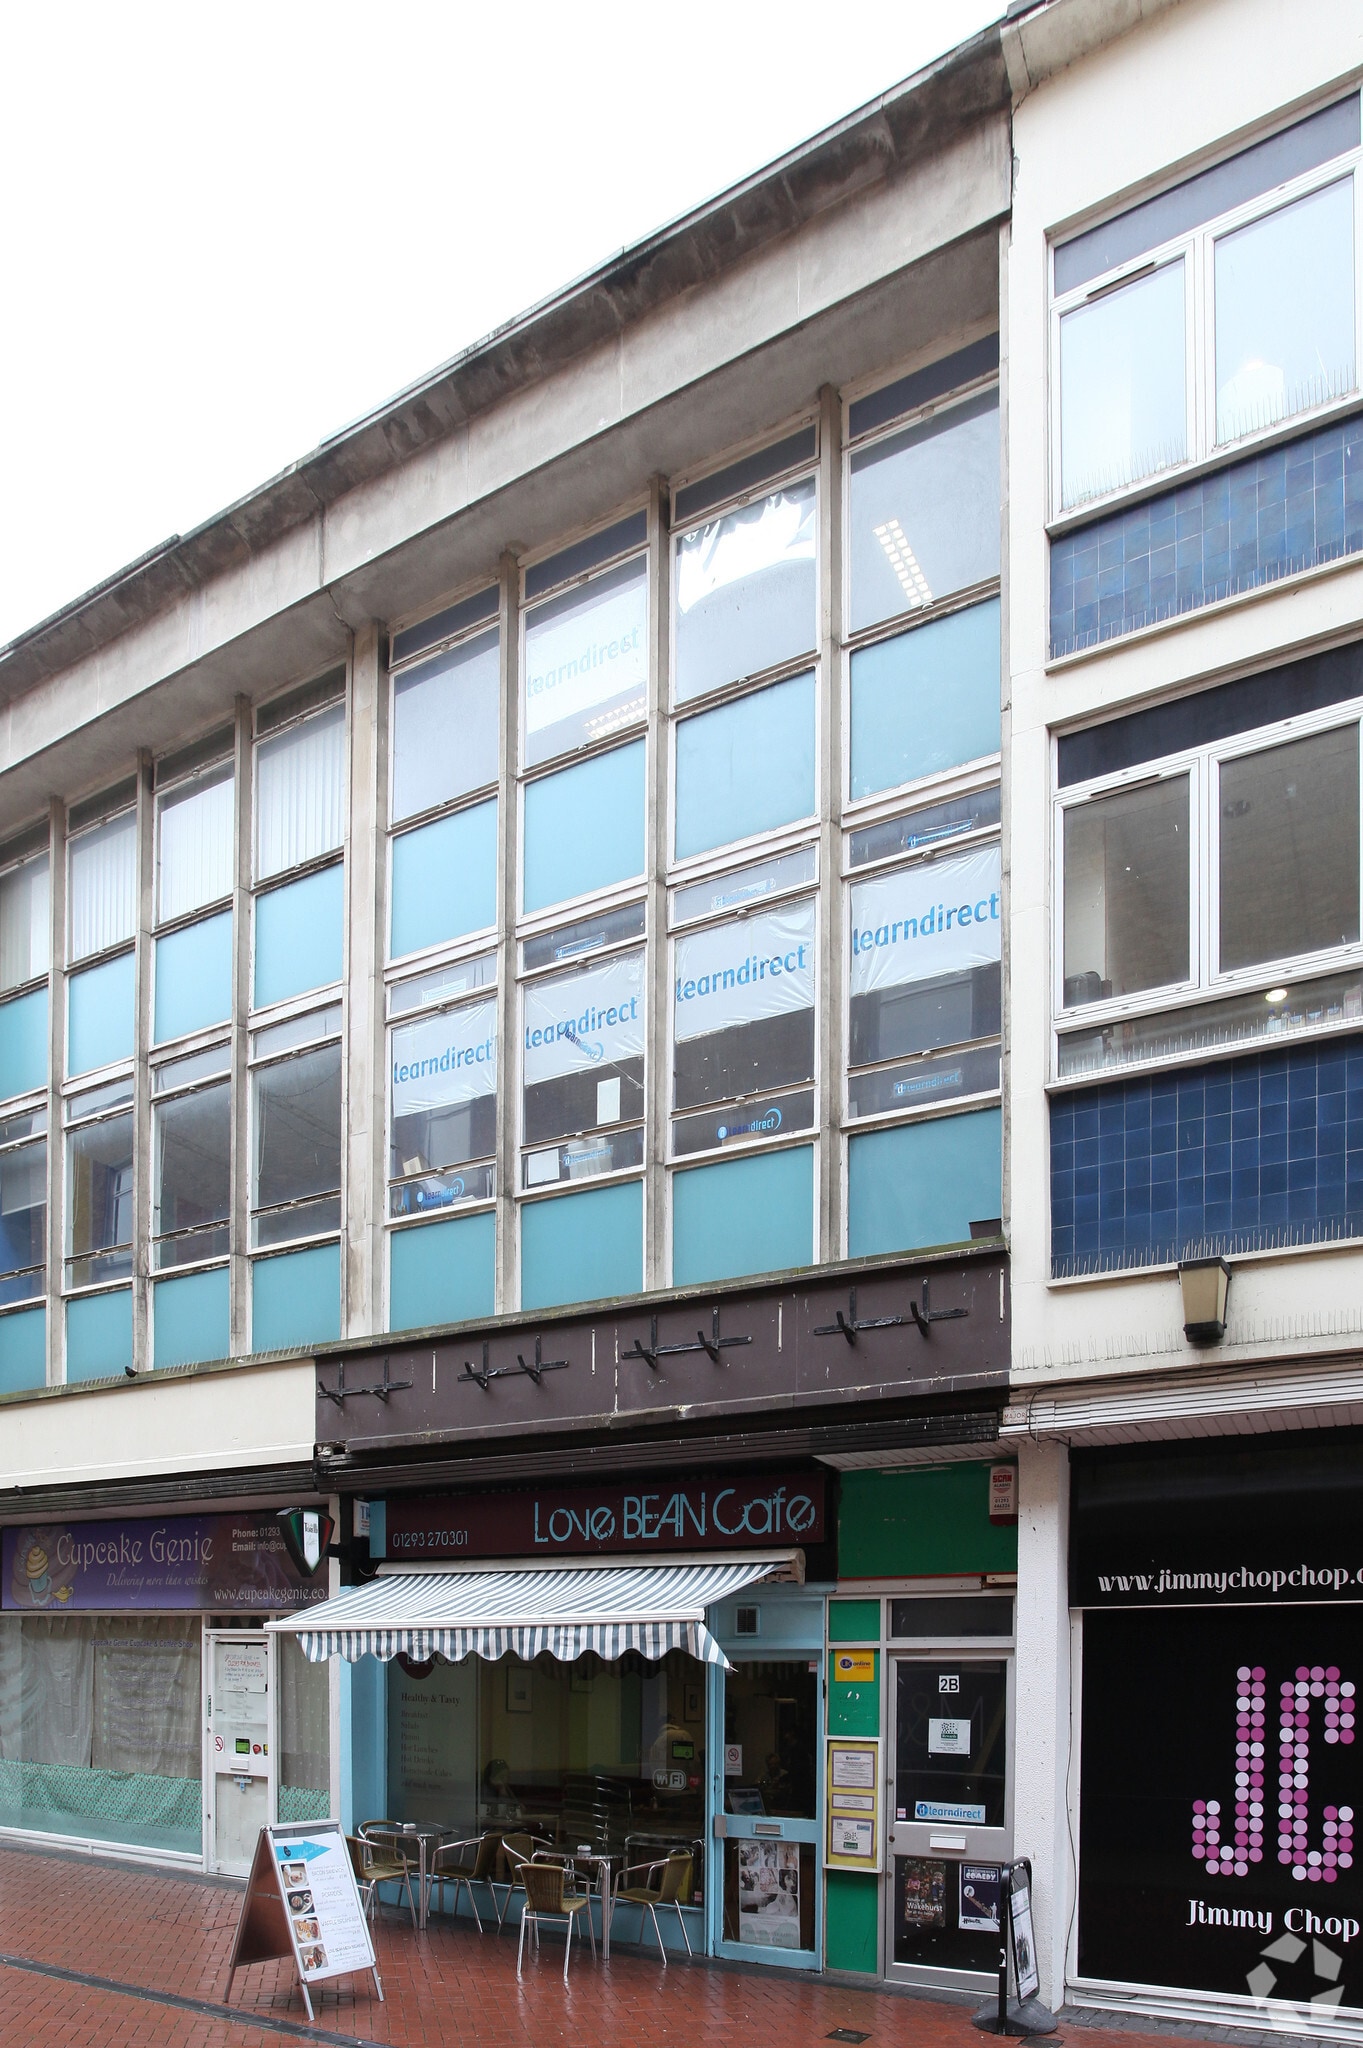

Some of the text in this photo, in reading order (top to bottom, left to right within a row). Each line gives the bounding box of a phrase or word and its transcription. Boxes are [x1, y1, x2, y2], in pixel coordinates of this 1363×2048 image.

[527, 627, 639, 698] learndirect
[853, 893, 999, 956] learndirect
[677, 945, 806, 1002] learndirect
[526, 997, 637, 1050] learndirect
[394, 1039, 492, 1084] learndirect
[993, 1474, 1012, 1483] SCAN
[534, 1486, 816, 1543] Love BEAN Cafe
[232, 1527, 281, 1538] Phone: 01293
[393, 1530, 468, 1547] 01293 270301
[57, 1528, 214, 1573] Cupcake Genie
[232, 1541, 256, 1551] Email:
[107, 1567, 145, 1599] Delivering
[940, 1678, 959, 1691] 2B
[401, 1692, 460, 1707] Healthy & Tasty
[929, 1804, 981, 1819] learndirect
[966, 1872, 997, 1881] COMEDY
[906, 1902, 943, 1912] Wakehurst
[1186, 1899, 1360, 1942] Jimmy Chop
